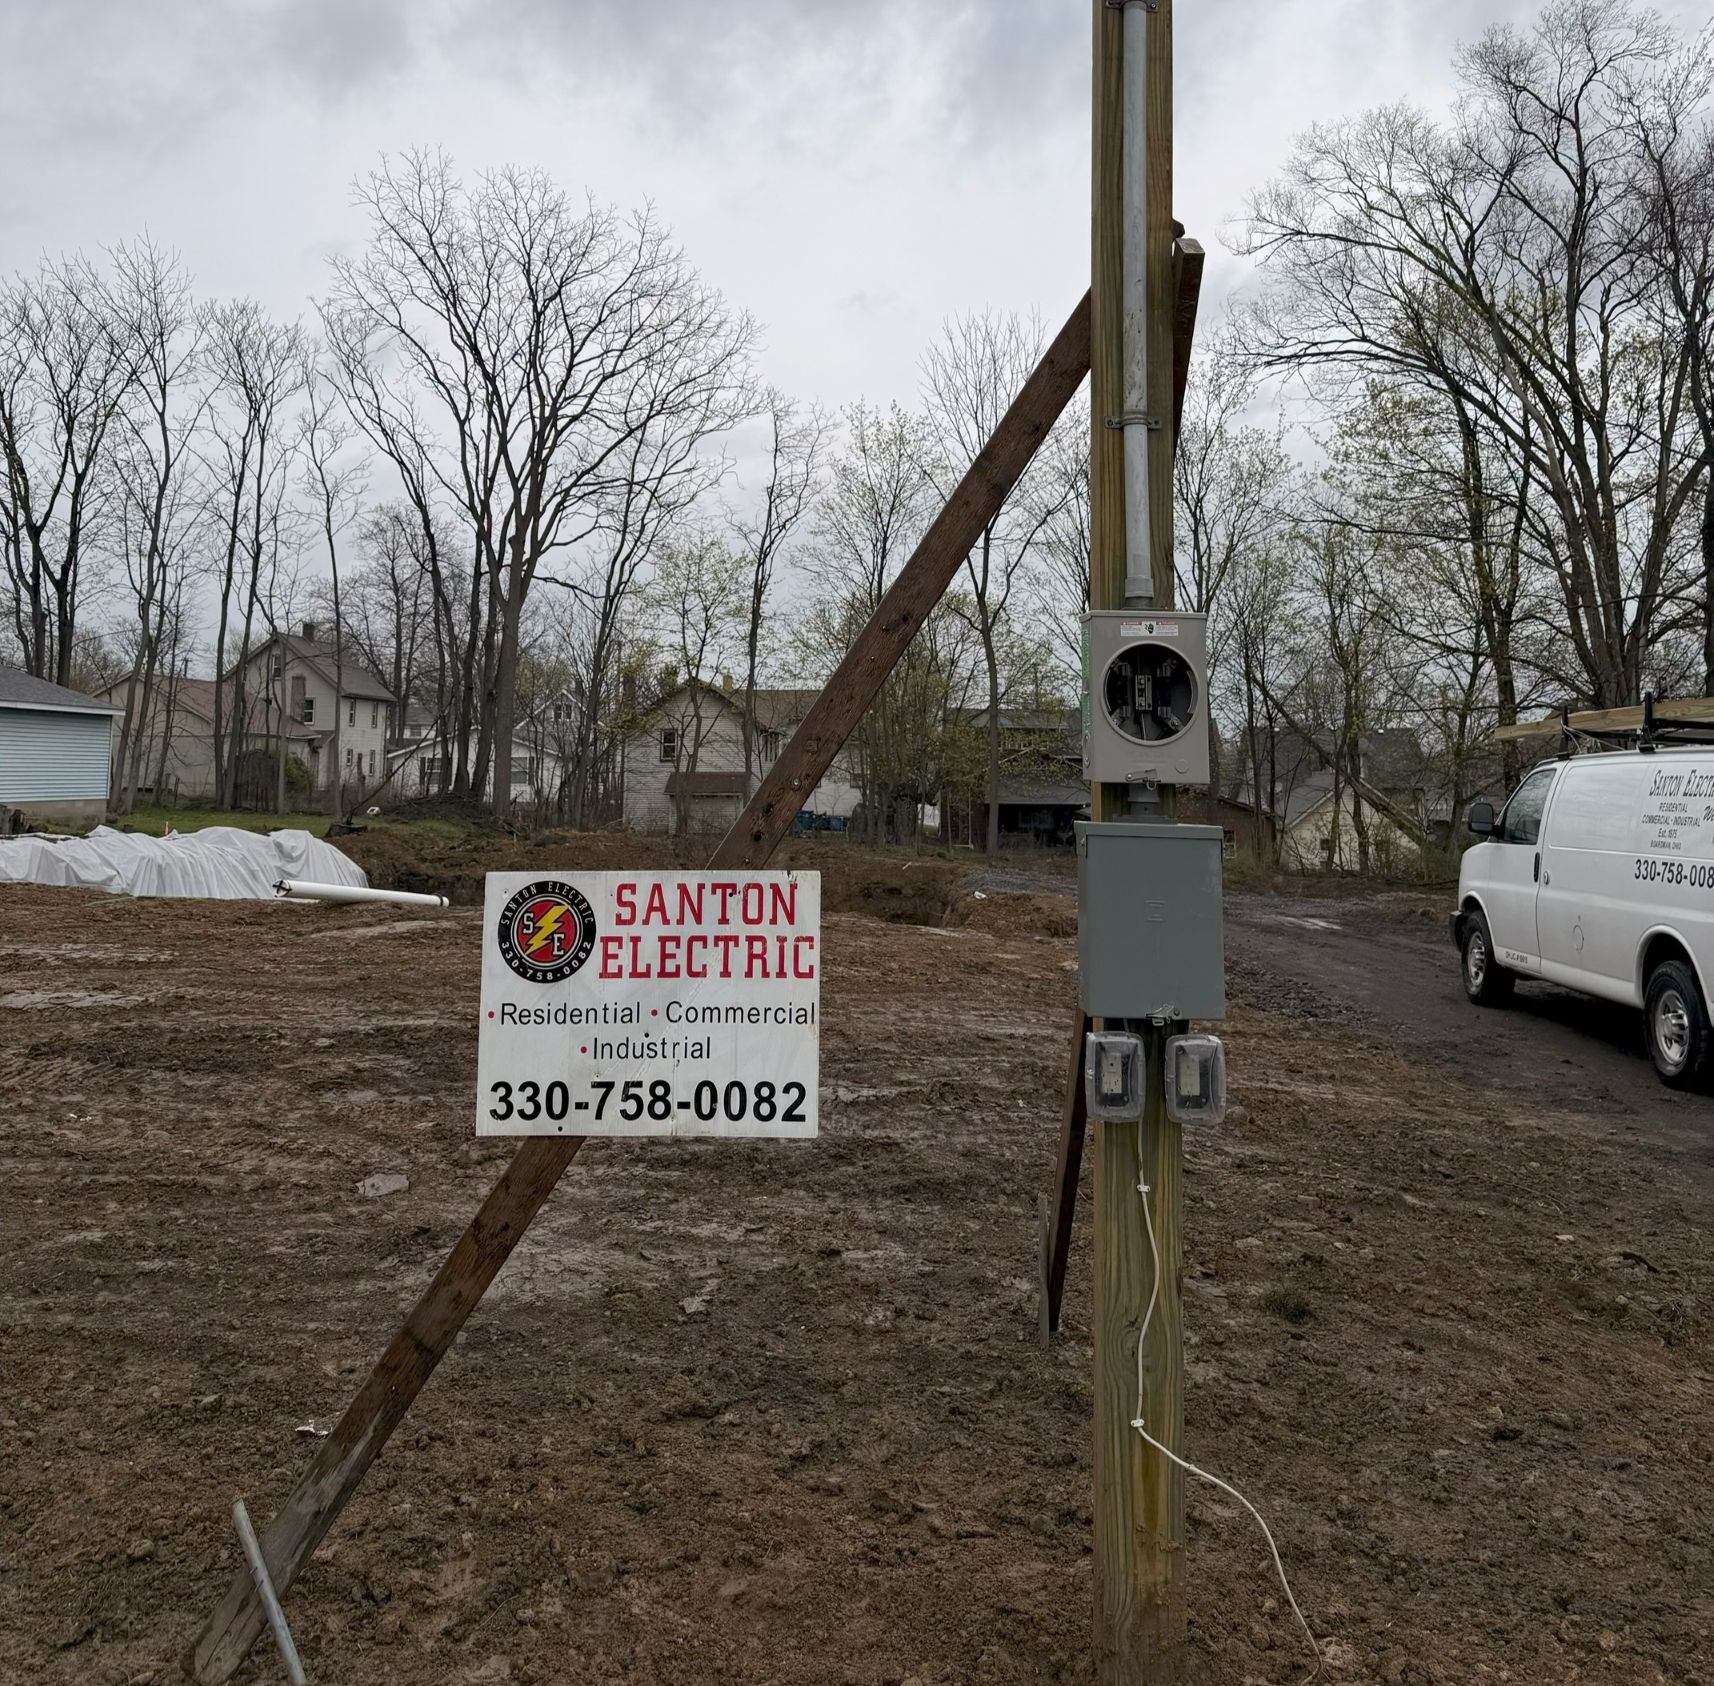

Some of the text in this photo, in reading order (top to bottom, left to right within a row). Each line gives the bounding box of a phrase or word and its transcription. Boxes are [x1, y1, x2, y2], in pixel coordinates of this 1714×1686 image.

[1649, 769, 1685, 797] SANTON
[1641, 814, 1701, 827] COMMERCIAL INDUSTRIAL
[1659, 802, 1688, 813] RESIDENTIAL
[500, 881, 594, 926] SANTON ELECTRIC
[615, 882, 798, 926] SANTON
[523, 912, 534, 934] S
[552, 933, 565, 955] E
[598, 935, 815, 979] ELECTRIC
[501, 941, 592, 981] 330-758-0082
[500, 1001, 816, 1025] Residential Commercial
[593, 1036, 711, 1060] Industrial
[489, 1079, 807, 1123] 330-758-0082
